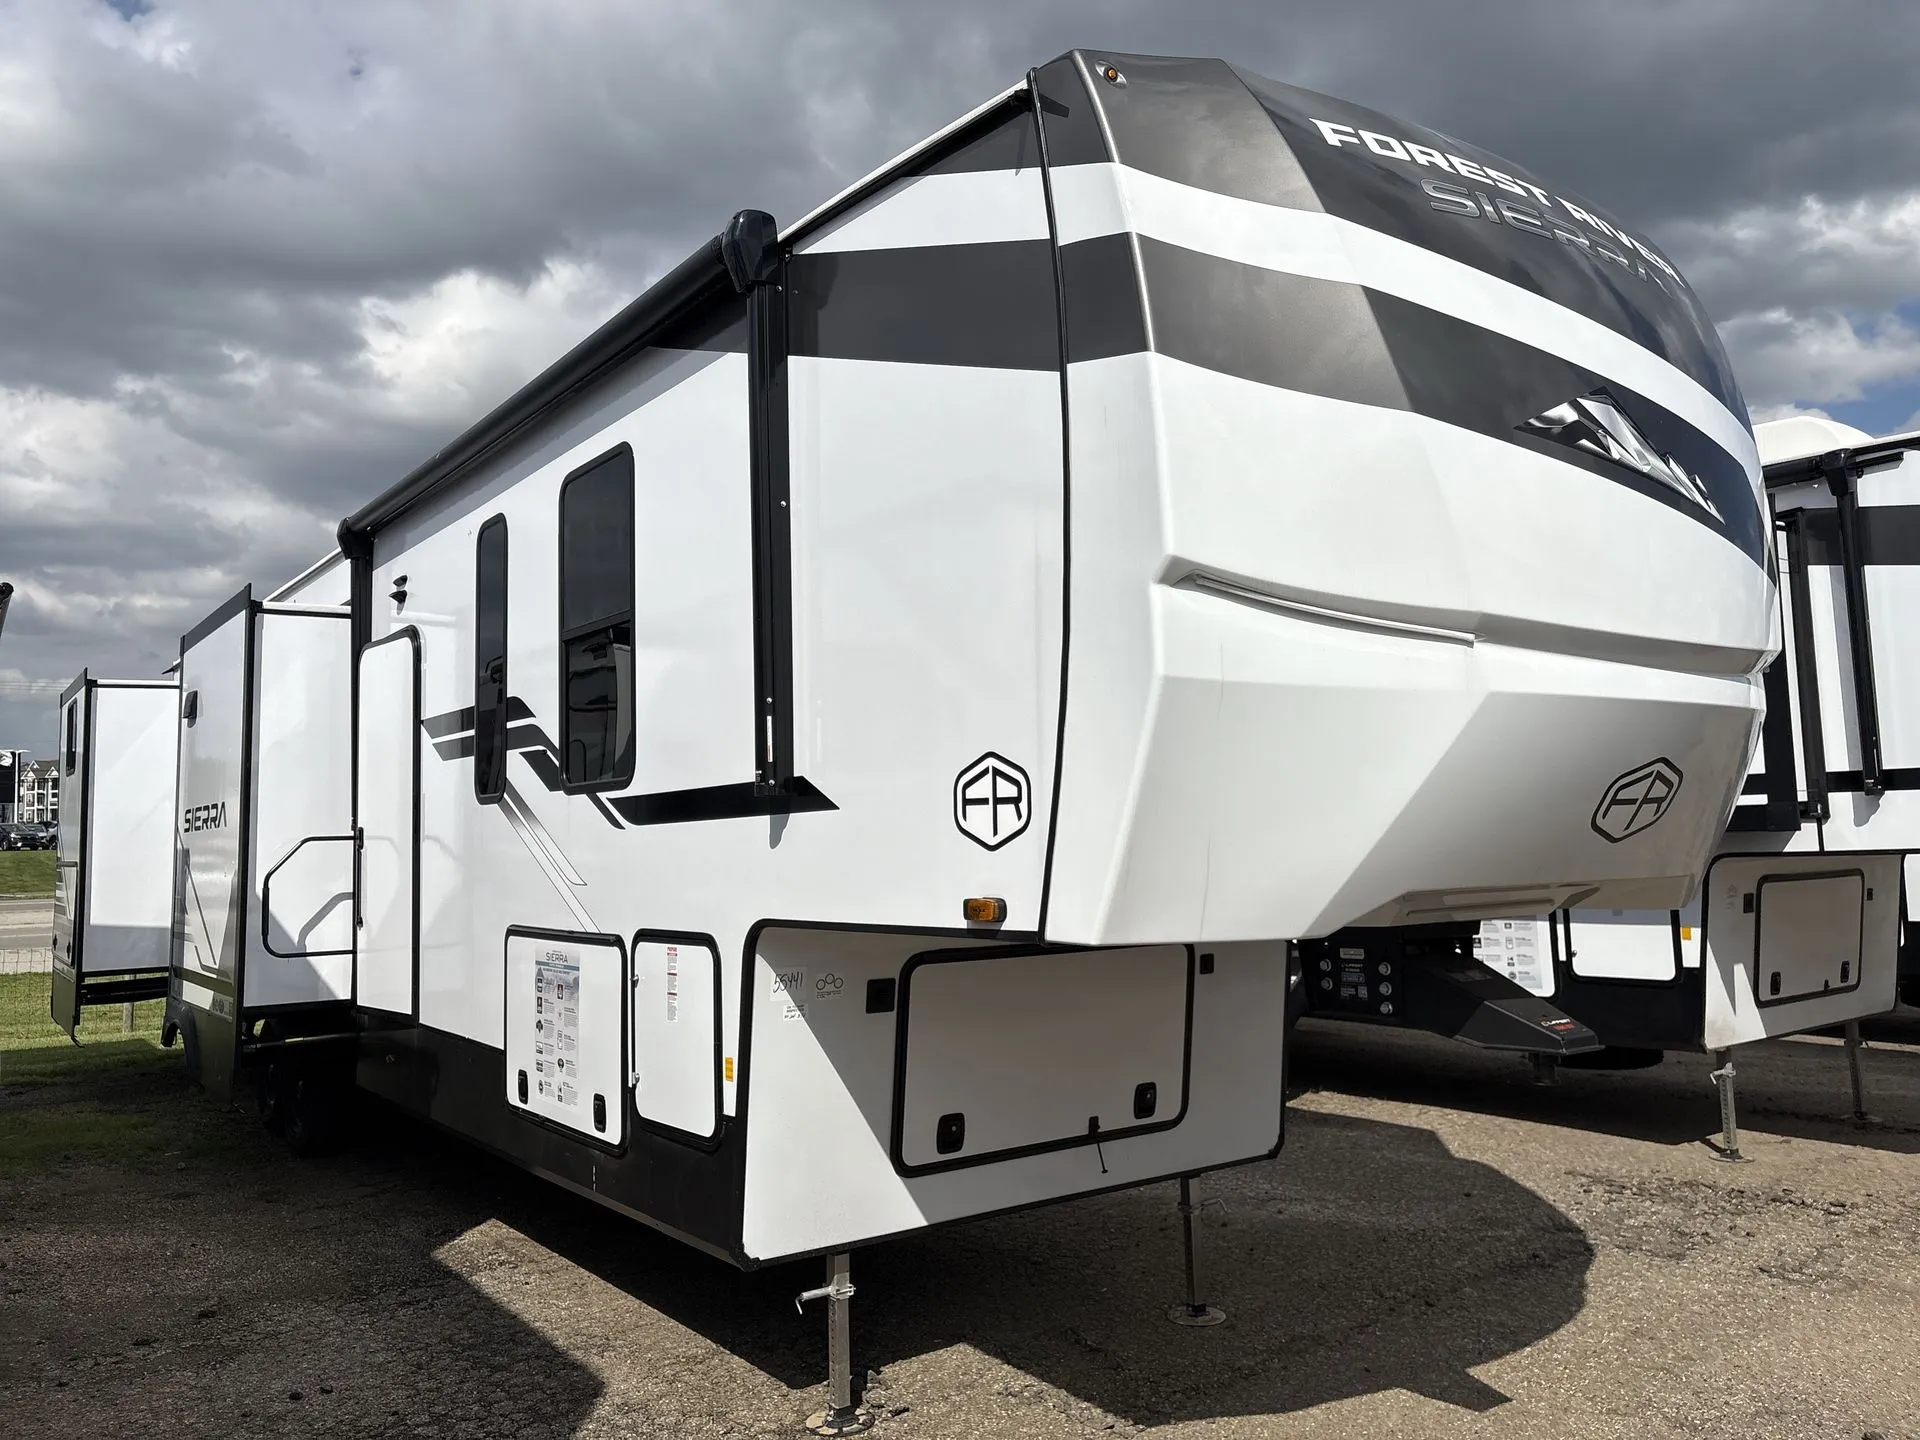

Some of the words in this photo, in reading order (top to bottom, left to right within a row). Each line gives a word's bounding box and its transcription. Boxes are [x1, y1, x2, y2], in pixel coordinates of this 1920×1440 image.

[1309, 117, 1553, 206] FOREST
[1555, 195, 1686, 288] RIVER
[184, 802, 227, 832] SIERRA
